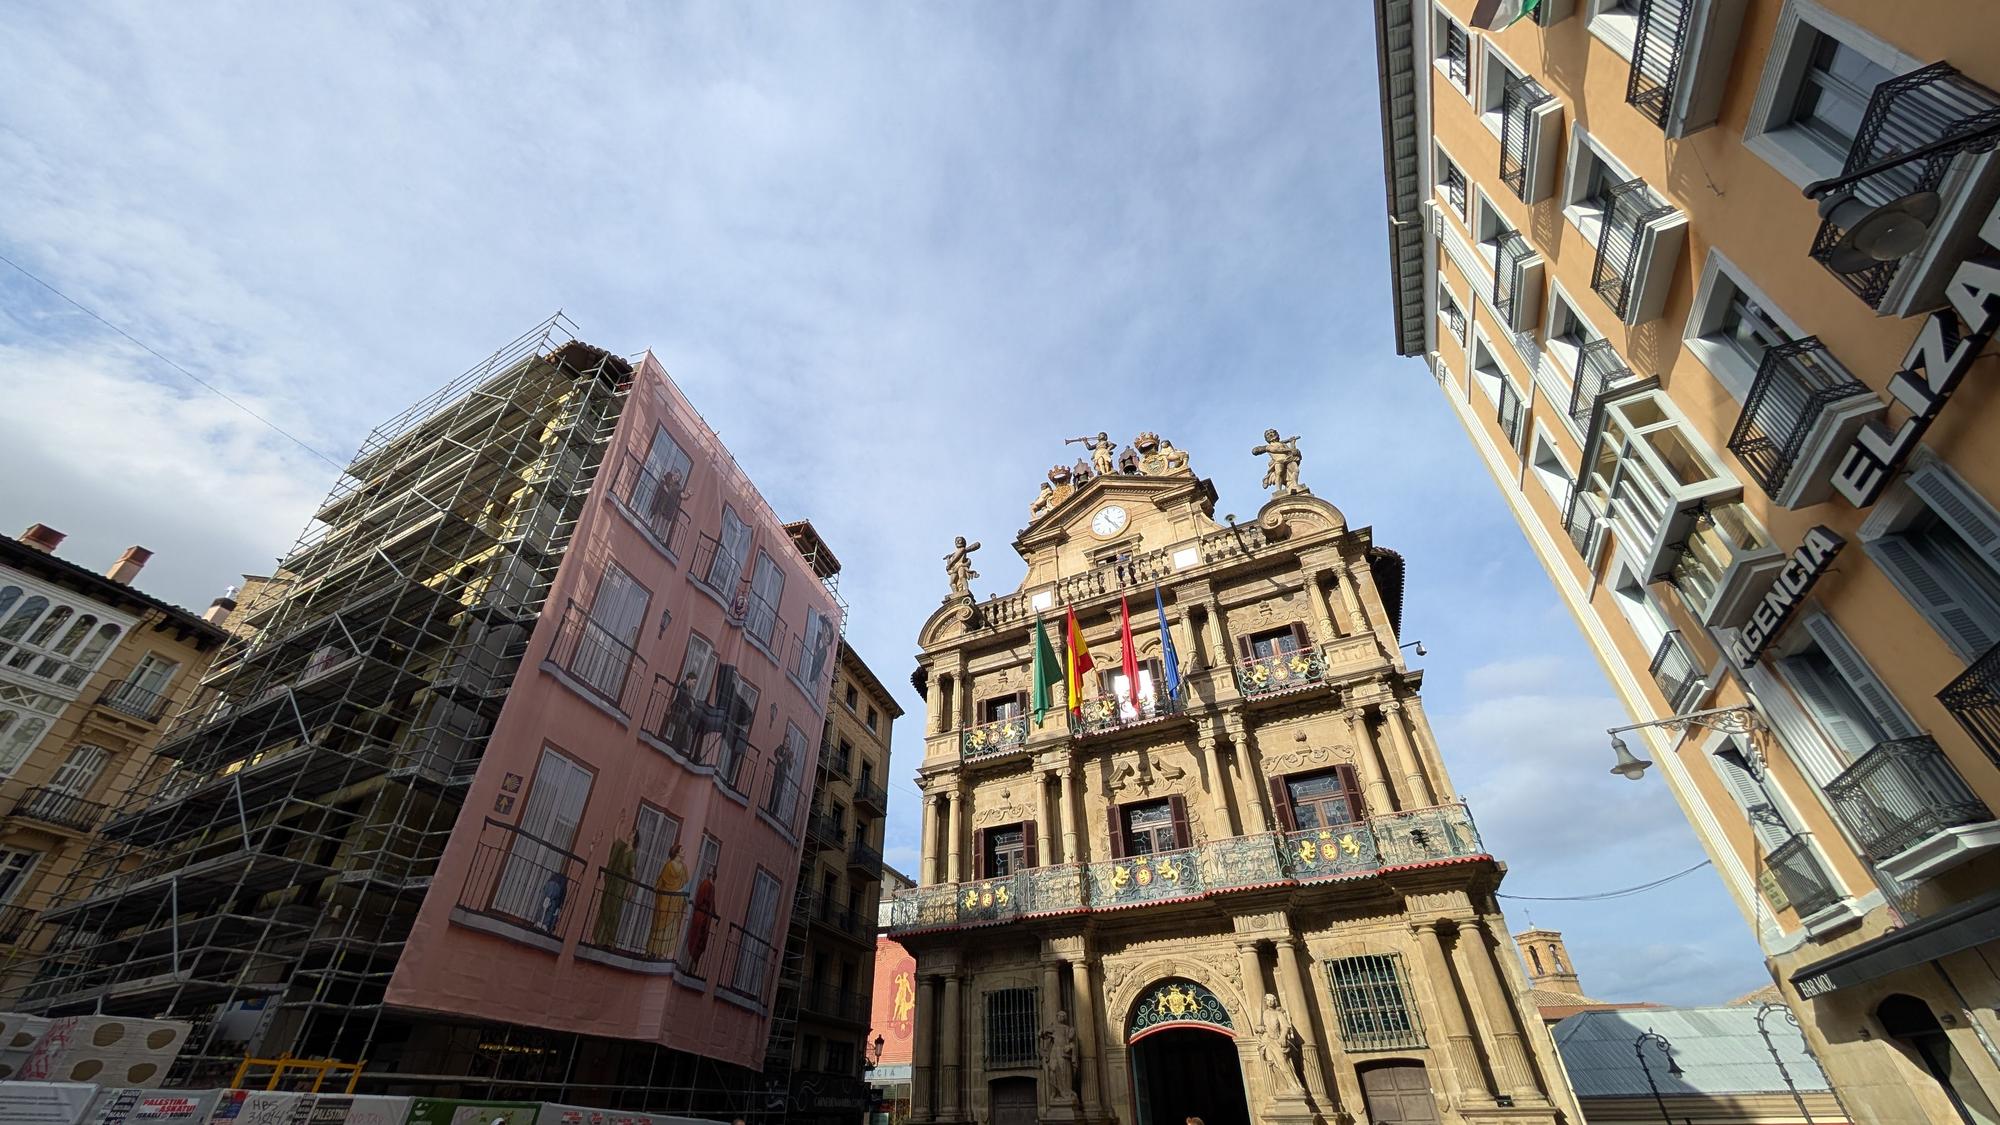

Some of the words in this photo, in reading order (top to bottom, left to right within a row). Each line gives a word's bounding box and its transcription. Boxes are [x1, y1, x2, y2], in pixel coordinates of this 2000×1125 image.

[1731, 526, 1843, 669] AGENCIA
[1829, 195, 2000, 509] ELIZA
[1799, 980, 1820, 998] BAR
